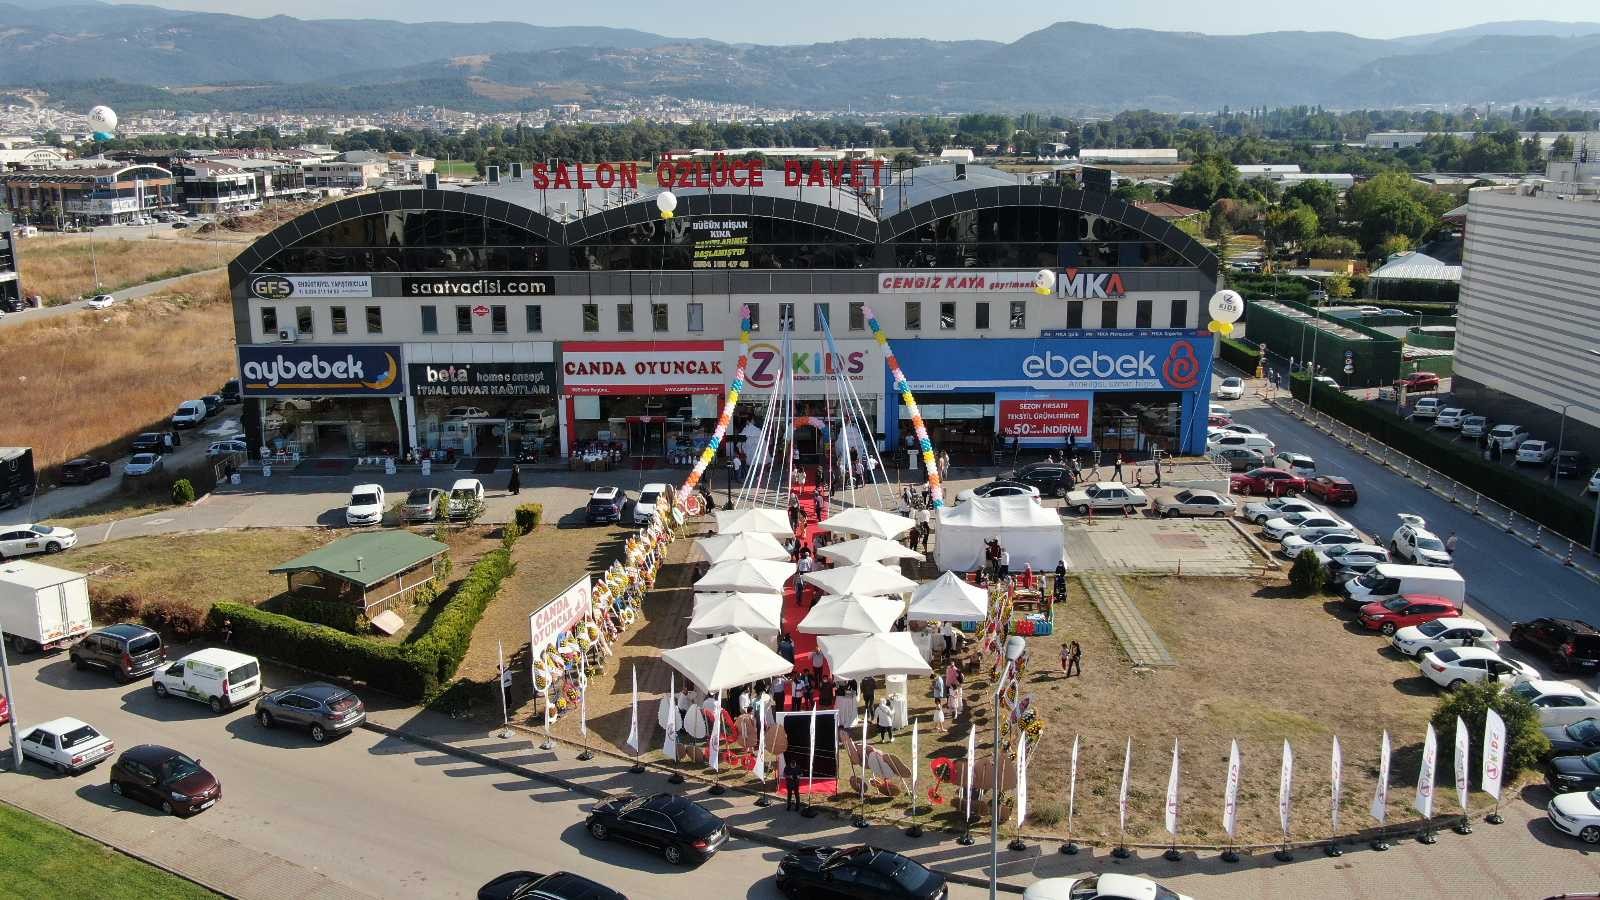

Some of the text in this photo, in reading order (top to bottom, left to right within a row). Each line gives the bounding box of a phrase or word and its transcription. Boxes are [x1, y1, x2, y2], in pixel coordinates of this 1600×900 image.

[533, 152, 885, 189] SALON ÖZLÜCE DAVET
[692, 219, 748, 231] DÜĞÜN NİŞAN
[709, 230, 732, 238] KINA
[255, 281, 290, 294] GFS
[411, 279, 546, 294] saatvadisi.com
[945, 275, 985, 289] KAYA
[1058, 267, 1126, 299] MKA
[243, 354, 365, 387] aybebek
[564, 360, 723, 376] CANDA OYUNCAK
[752, 351, 775, 382] Z
[1022, 350, 1156, 378] ebebek
[426, 365, 468, 383] beta
[451, 385, 489, 396] DUVAR
[535, 596, 570, 629] CANDA
[533, 608, 575, 647] OYUNCAK
